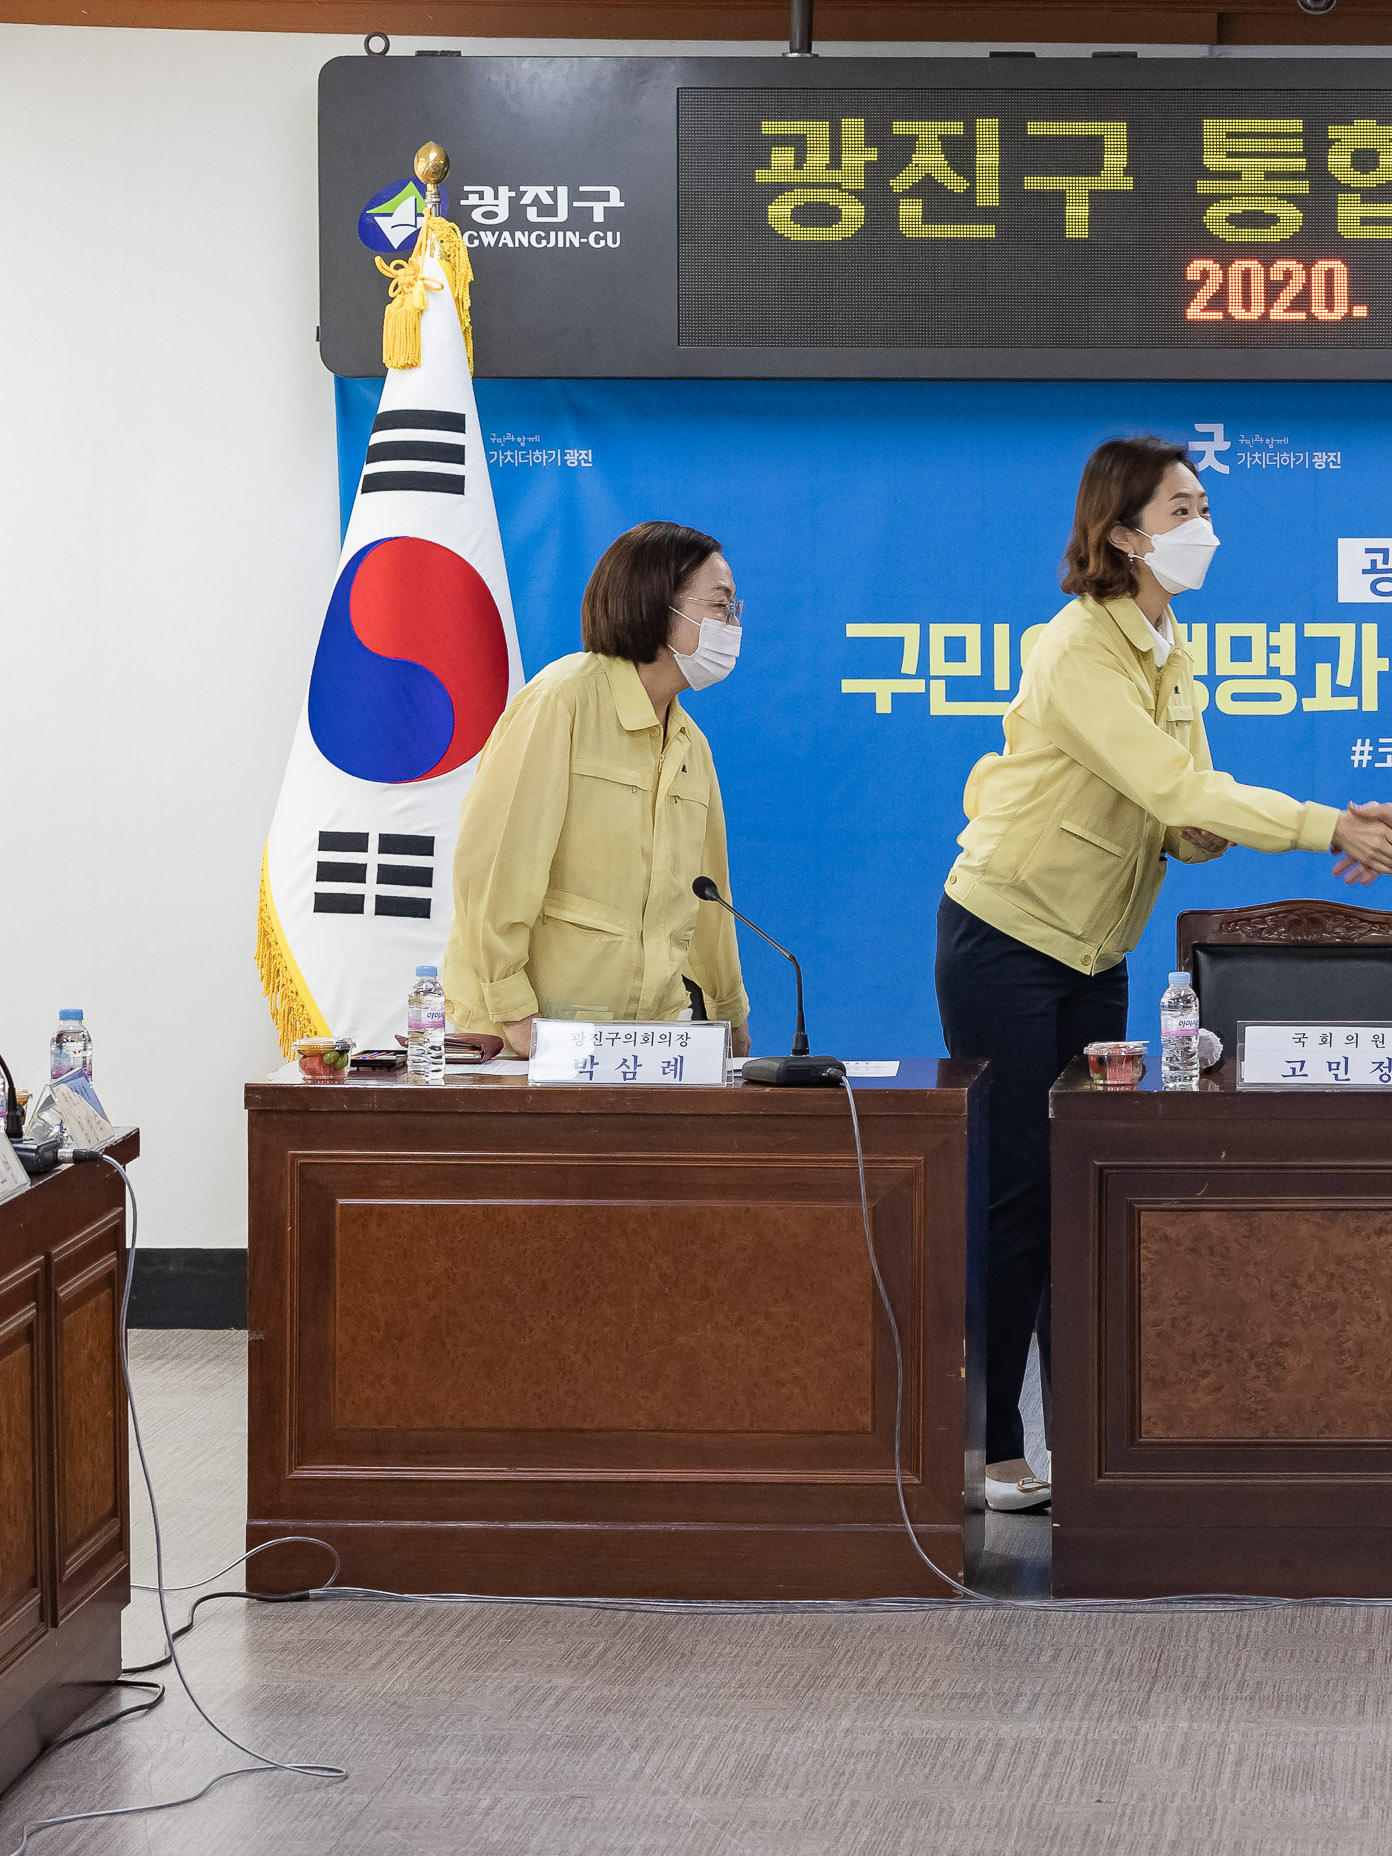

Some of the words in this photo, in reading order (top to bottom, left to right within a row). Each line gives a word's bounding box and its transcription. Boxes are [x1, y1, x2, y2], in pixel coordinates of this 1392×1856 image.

[755, 117, 1134, 240] 광진구
[460, 185, 625, 225] 광진구
[463, 230, 621, 248] GWANGJIN-GU
[1185, 259, 1369, 321] 2020.
[488, 449, 562, 467] 가치더하기
[563, 449, 593, 467] 광진
[1236, 451, 1309, 469] 가치더하기
[1311, 451, 1342, 470] 광진
[841, 622, 1045, 717] 구민
[571, 1030, 692, 1048] 광진구의회의장
